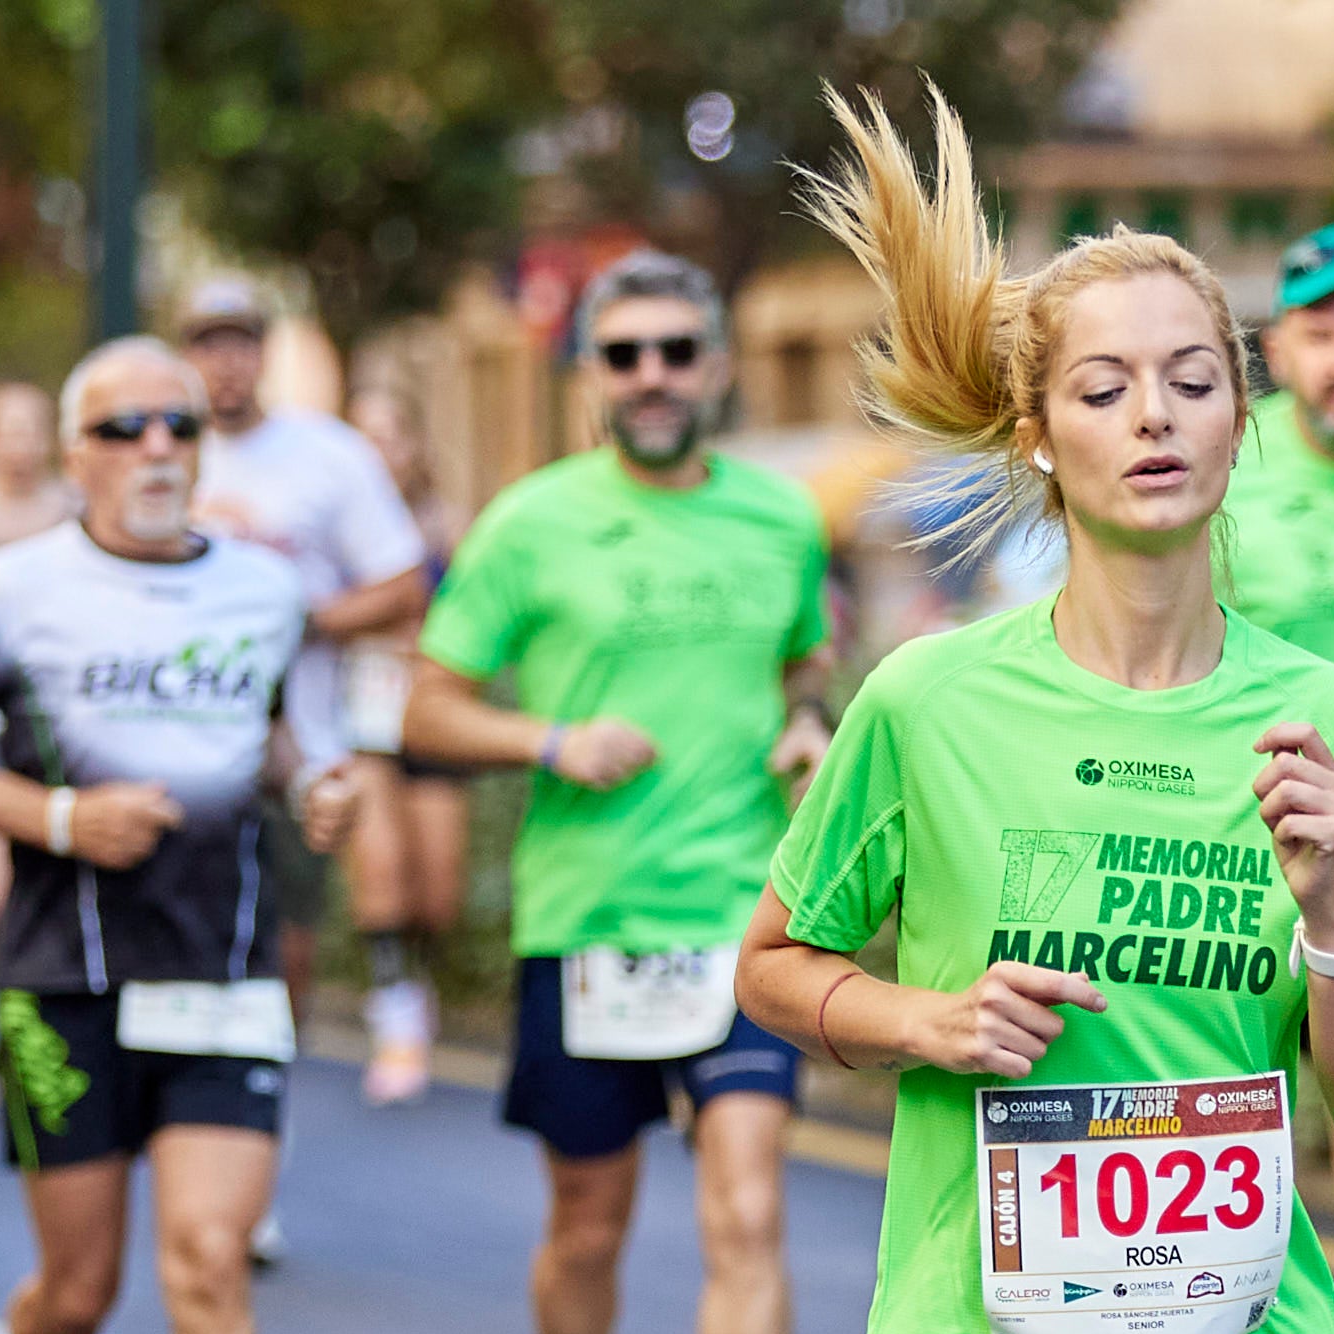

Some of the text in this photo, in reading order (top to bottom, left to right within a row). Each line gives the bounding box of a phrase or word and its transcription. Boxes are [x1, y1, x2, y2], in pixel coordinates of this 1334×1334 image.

[1108, 761, 1195, 781] OXIMESA
[1108, 779, 1196, 796] NIPPON GASES
[1096, 833, 1273, 887] MEMORIAL
[999, 829, 1101, 922] 17
[1097, 876, 1265, 938] PADRE
[988, 929, 1277, 995] MARCELINO
[1091, 1090, 1122, 1119] 17
[1121, 1088, 1179, 1102] MEMORIAL
[1217, 1090, 1276, 1104] OXIMESA
[1010, 1101, 1072, 1113] OXIMESA
[1123, 1101, 1175, 1119] PADRE
[1218, 1101, 1277, 1114] NIPPON GASES
[1010, 1113, 1073, 1123] NIPPON GASES
[1088, 1116, 1182, 1137] MARCELINO
[1040, 1146, 1266, 1239] 1023
[994, 1170, 1017, 1246] CAJÓN 4
[1126, 1244, 1183, 1267] ROSA
[1129, 1281, 1174, 1291] OXIMESA
[1233, 1268, 1273, 1288] ANAYA
[997, 1288, 1050, 1299] CALERO
[1161, 1308, 1194, 1317] HUERTAS
[1128, 1321, 1165, 1330] SENIOR
